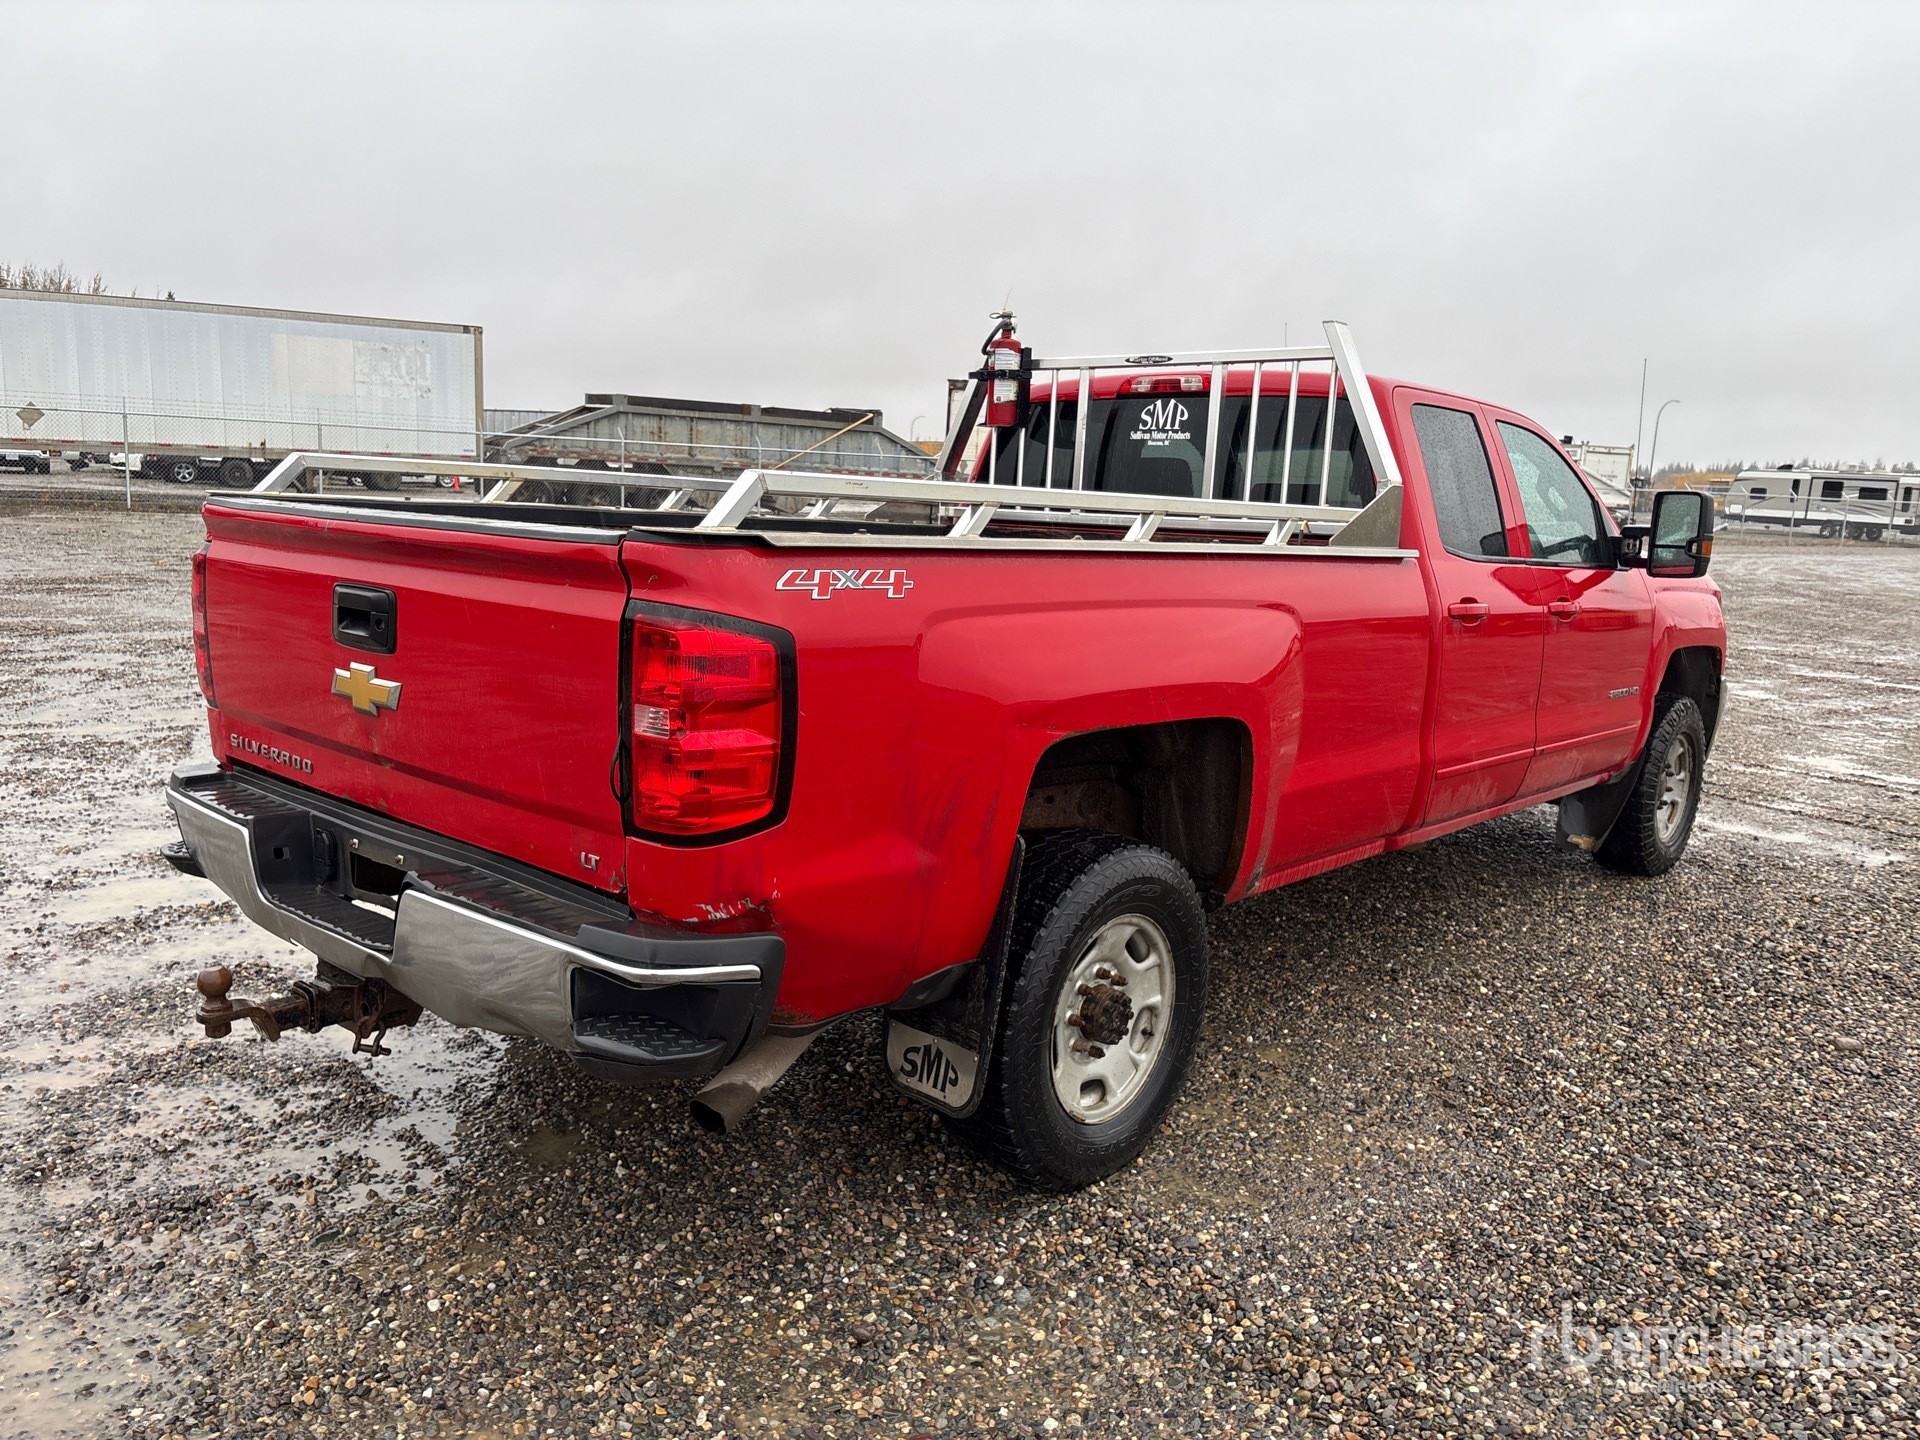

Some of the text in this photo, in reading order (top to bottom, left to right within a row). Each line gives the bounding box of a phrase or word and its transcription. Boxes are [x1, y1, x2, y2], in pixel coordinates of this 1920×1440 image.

[1138, 398, 1189, 430] SMP
[1129, 430, 1191, 440] Sullivan Motor Products
[230, 733, 313, 775] SILVERADO
[580, 851, 600, 871] LT
[900, 1043, 959, 1093] SMP
